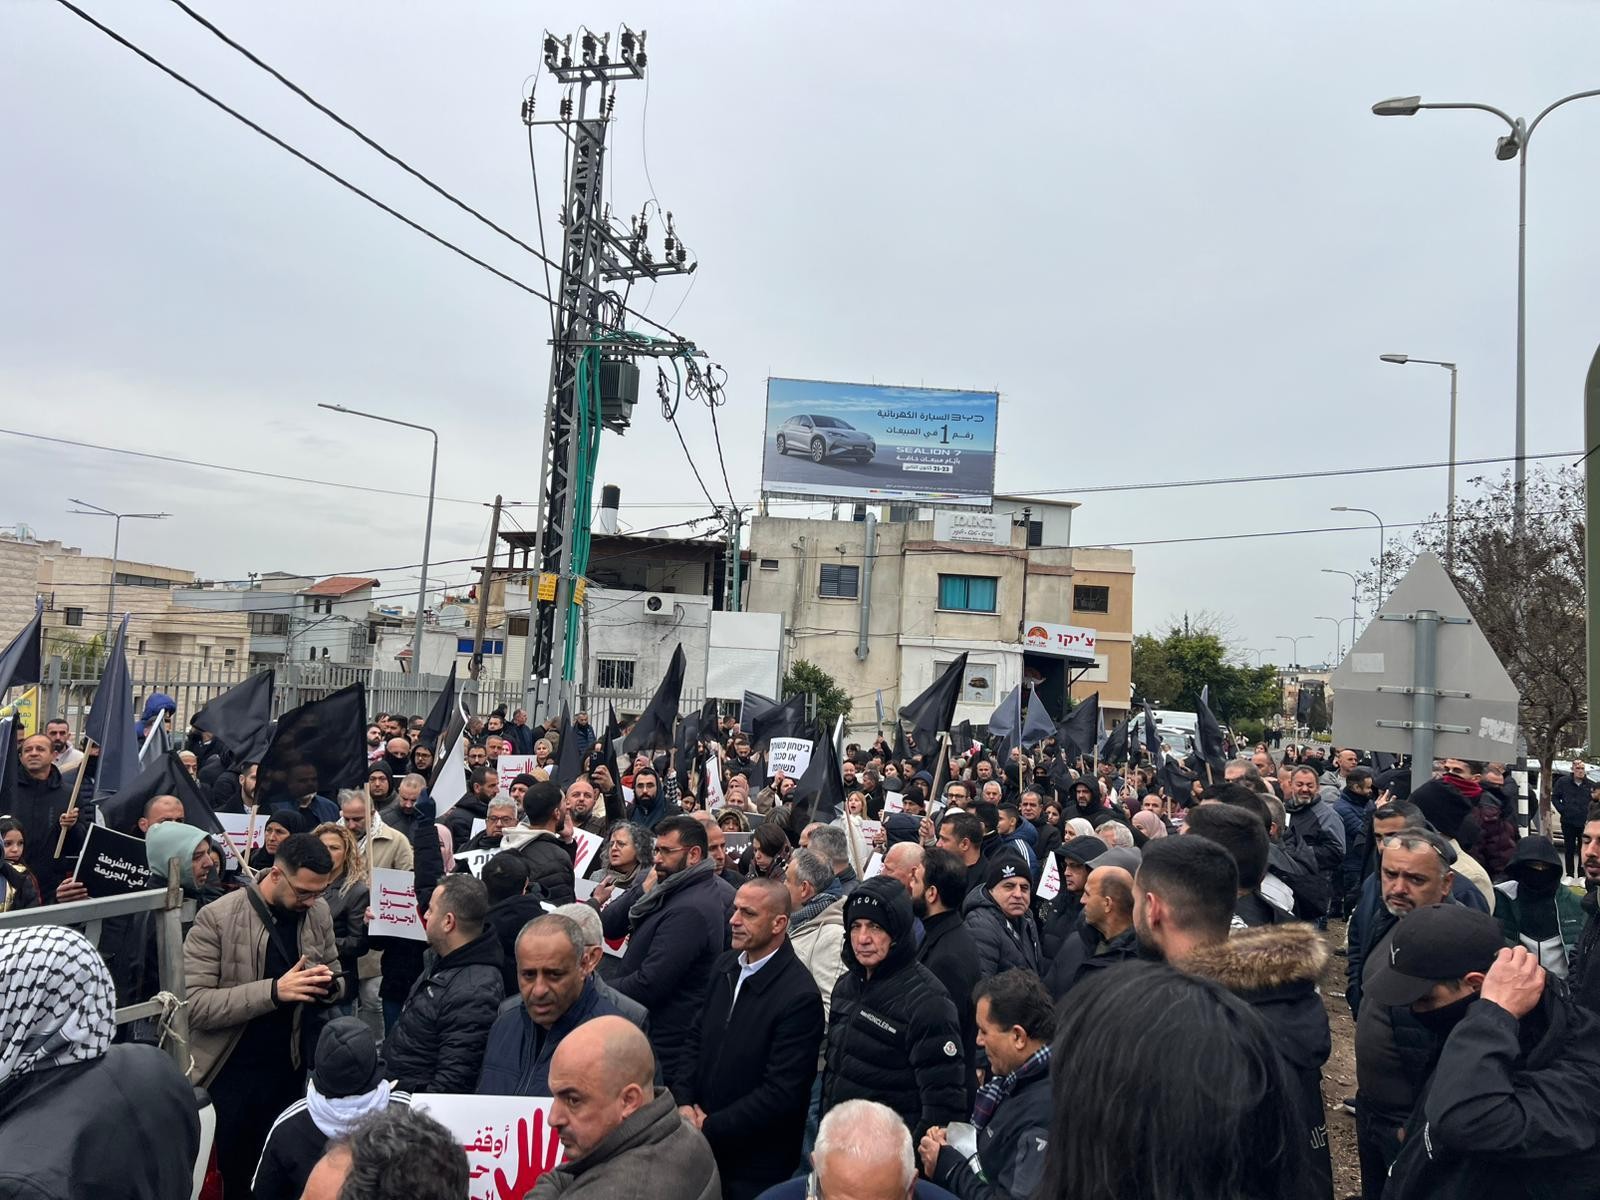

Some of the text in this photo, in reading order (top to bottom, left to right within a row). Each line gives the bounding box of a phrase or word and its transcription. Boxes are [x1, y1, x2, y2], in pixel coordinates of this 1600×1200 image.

[877, 408, 918, 420] الكهربائية
[920, 412, 950, 421] السيارة
[885, 426, 921, 436] المبيعات
[940, 424, 950, 445] 1
[895, 446, 950, 456] SEALION
[787, 741, 810, 753] ביטחון
[788, 753, 797, 762] או
[98, 852, 137, 874] والشرطة
[94, 863, 128, 881] الجريمة
[127, 876, 144, 888] في
[852, 896, 879, 907] ICON
[379, 911, 417, 926] الجريمة
[463, 1124, 510, 1159] أوقف
